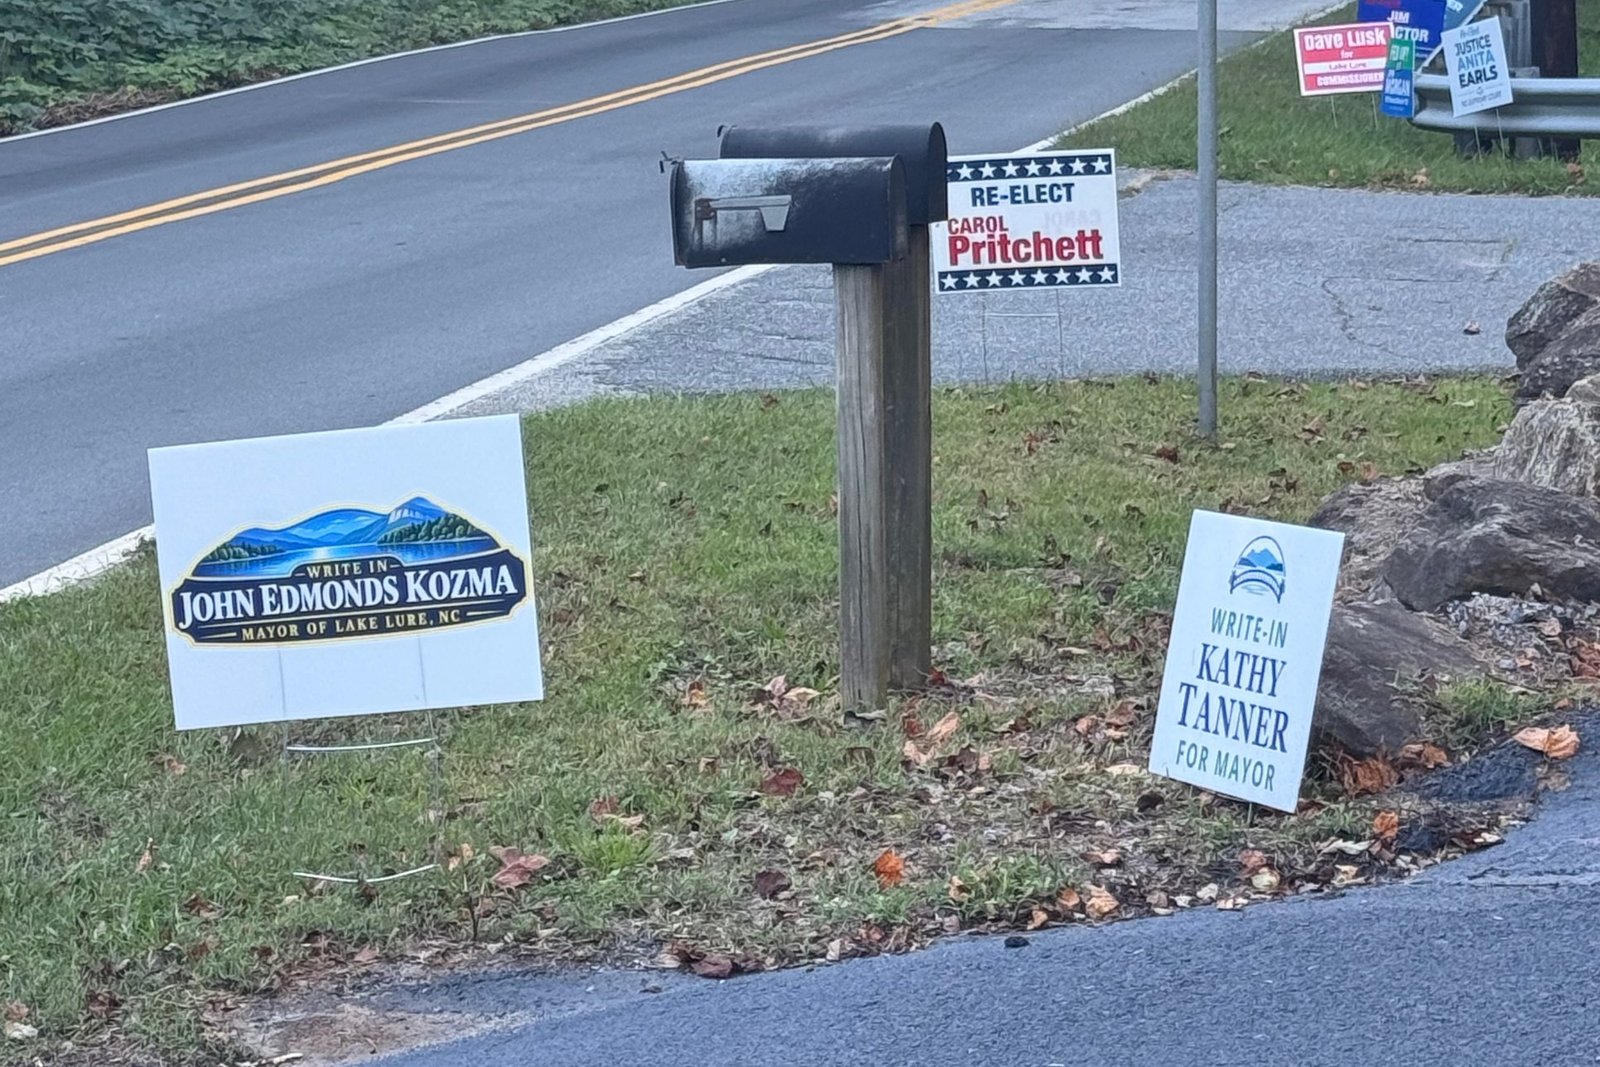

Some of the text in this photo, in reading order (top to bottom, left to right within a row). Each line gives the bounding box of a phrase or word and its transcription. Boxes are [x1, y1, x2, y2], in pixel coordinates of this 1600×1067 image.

[1387, 10, 1410, 24] JIM
[1304, 27, 1386, 51] Dave Lusk
[1454, 34, 1492, 56] JUSTICE
[1340, 49, 1354, 59] for
[1458, 49, 1495, 72] ANITA
[1459, 65, 1498, 88] EARLS
[971, 183, 1075, 207] RE-ELECT
[947, 215, 1009, 235] CAROL
[948, 229, 1104, 266] Pritchett
[306, 560, 387, 579] WRITE IN
[178, 564, 517, 631] JOHN EDMONDS KOZMA
[241, 609, 460, 641] MAYOR OF LAKE LURE, NC
[1211, 607, 1288, 648] WRITE-IN
[1196, 643, 1287, 698] KATHY
[1177, 682, 1289, 753] TANNER
[1176, 739, 1275, 792] FOR MAYOR
